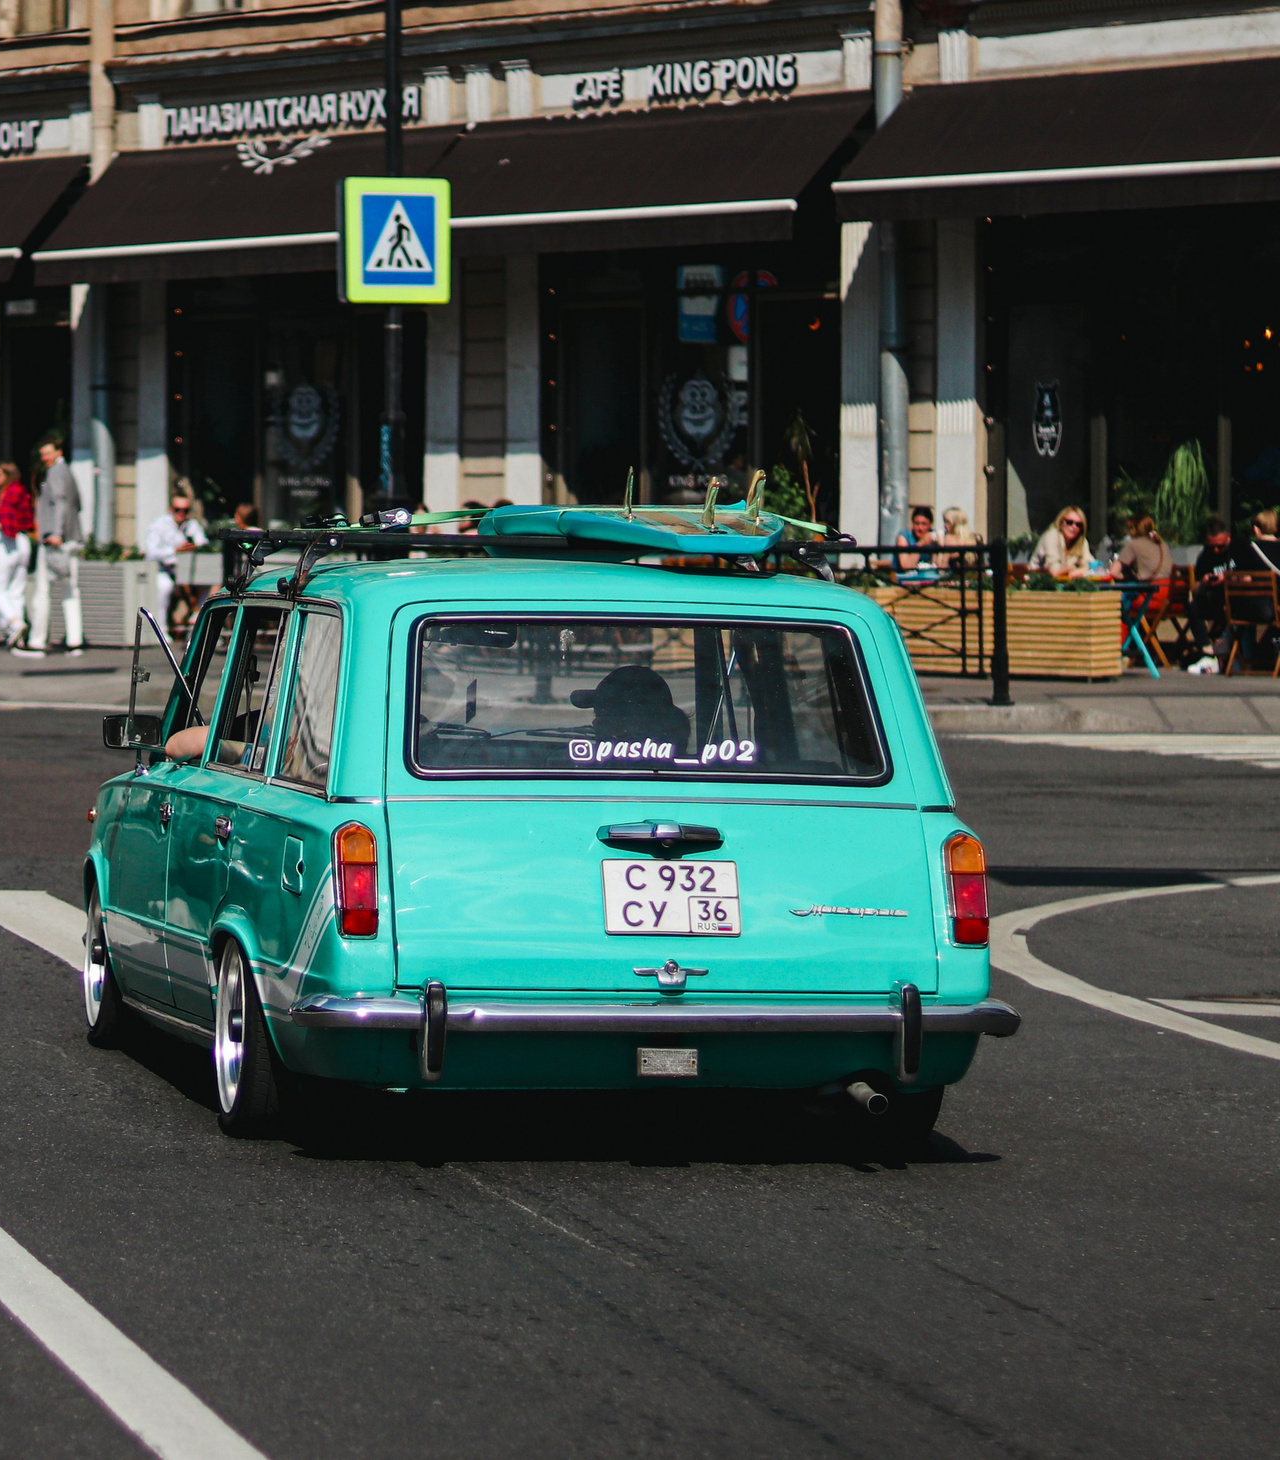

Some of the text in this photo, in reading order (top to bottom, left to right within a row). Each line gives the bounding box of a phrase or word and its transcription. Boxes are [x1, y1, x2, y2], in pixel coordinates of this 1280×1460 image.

[648, 61, 712, 97] KING
[719, 54, 796, 92] PONG
[163, 87, 420, 137] ПАНАЗИАТСКАЯ КУХЯ
[658, 864, 717, 893] 932
[697, 900, 728, 922] 36
[697, 922, 718, 931] RUS
